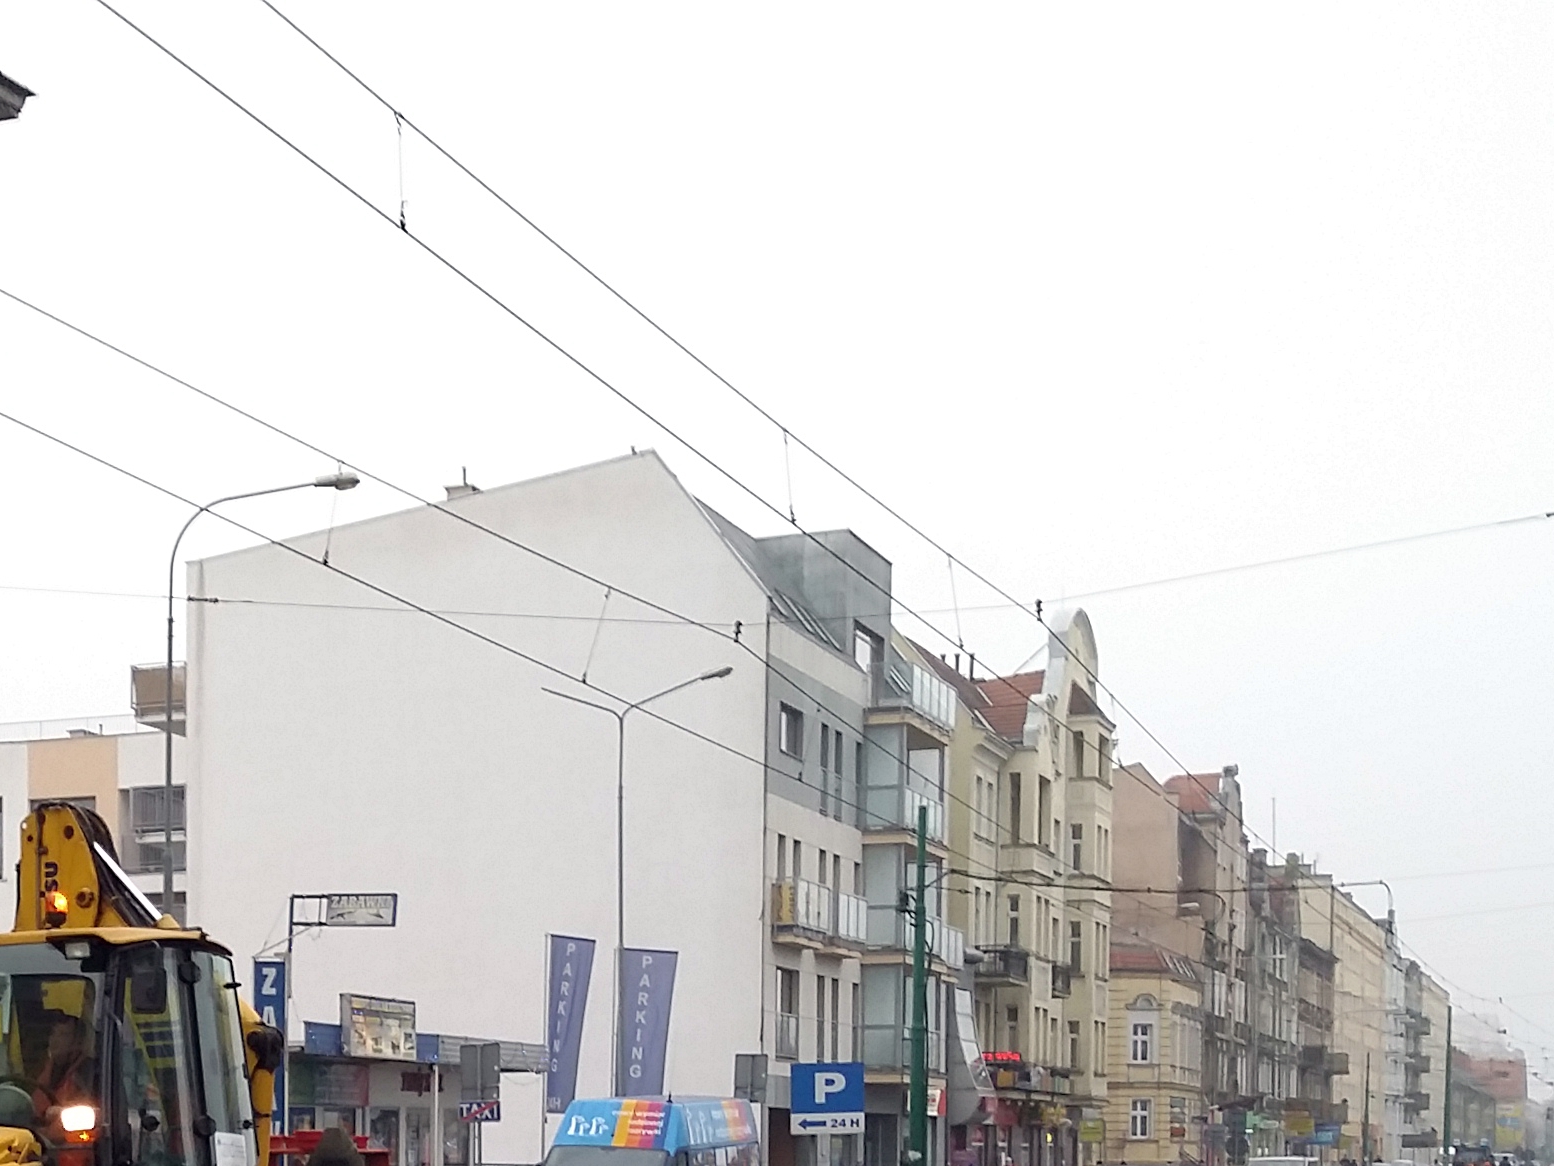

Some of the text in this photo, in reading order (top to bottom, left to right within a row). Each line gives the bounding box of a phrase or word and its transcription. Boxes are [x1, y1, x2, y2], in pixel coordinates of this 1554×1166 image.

[551, 942, 576, 1073] PARKING
[629, 955, 653, 1078] PARKING
[814, 1072, 847, 1105] P
[459, 1103, 498, 1119] TAXI
[830, 1118, 860, 1128] 24 H
